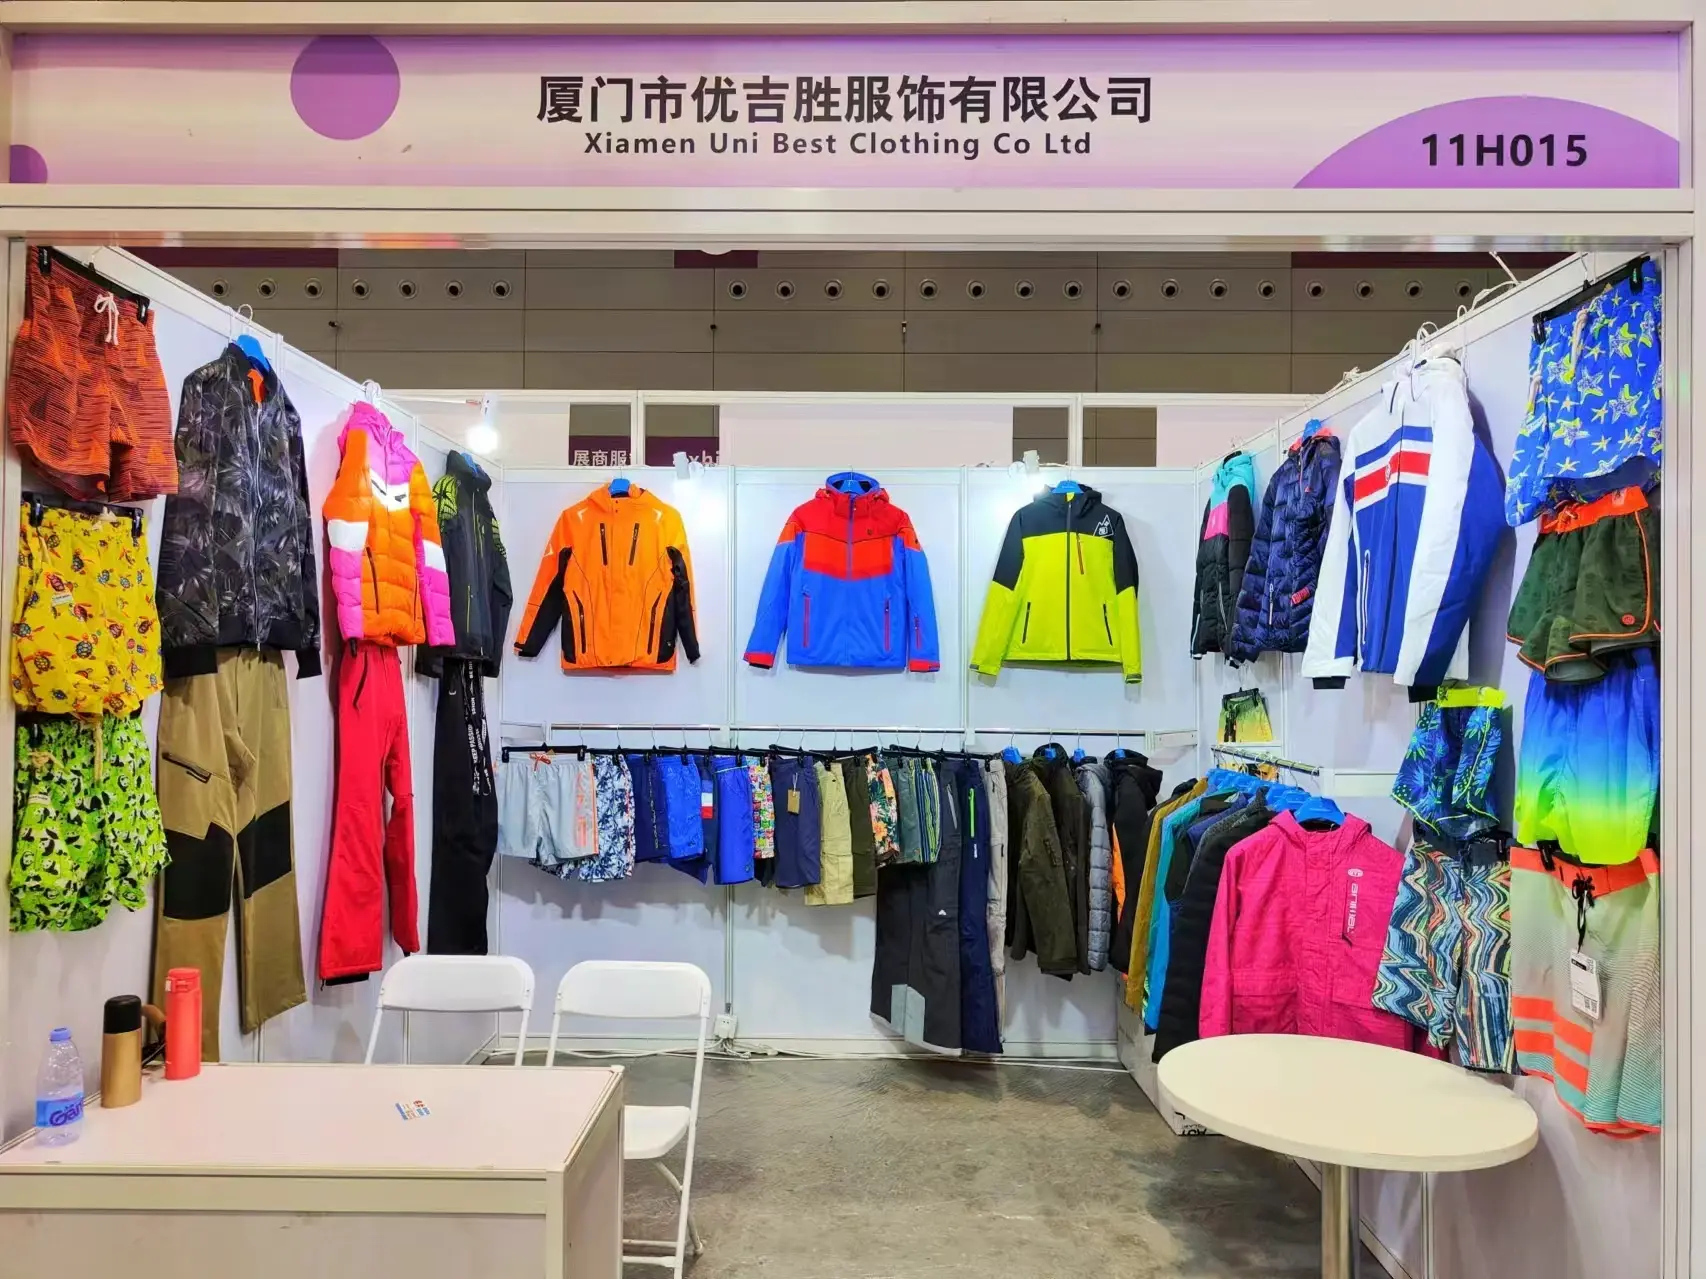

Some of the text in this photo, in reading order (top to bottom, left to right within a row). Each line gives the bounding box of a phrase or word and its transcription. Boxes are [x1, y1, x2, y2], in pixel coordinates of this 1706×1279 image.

[536, 74, 1151, 124] 厦门市优吉胜服饰有限公司
[584, 131, 1091, 161] Xiamen Uni Best Clothing Co Ltd
[1422, 133, 1587, 167] 11H015
[573, 449, 631, 466] 展商服
